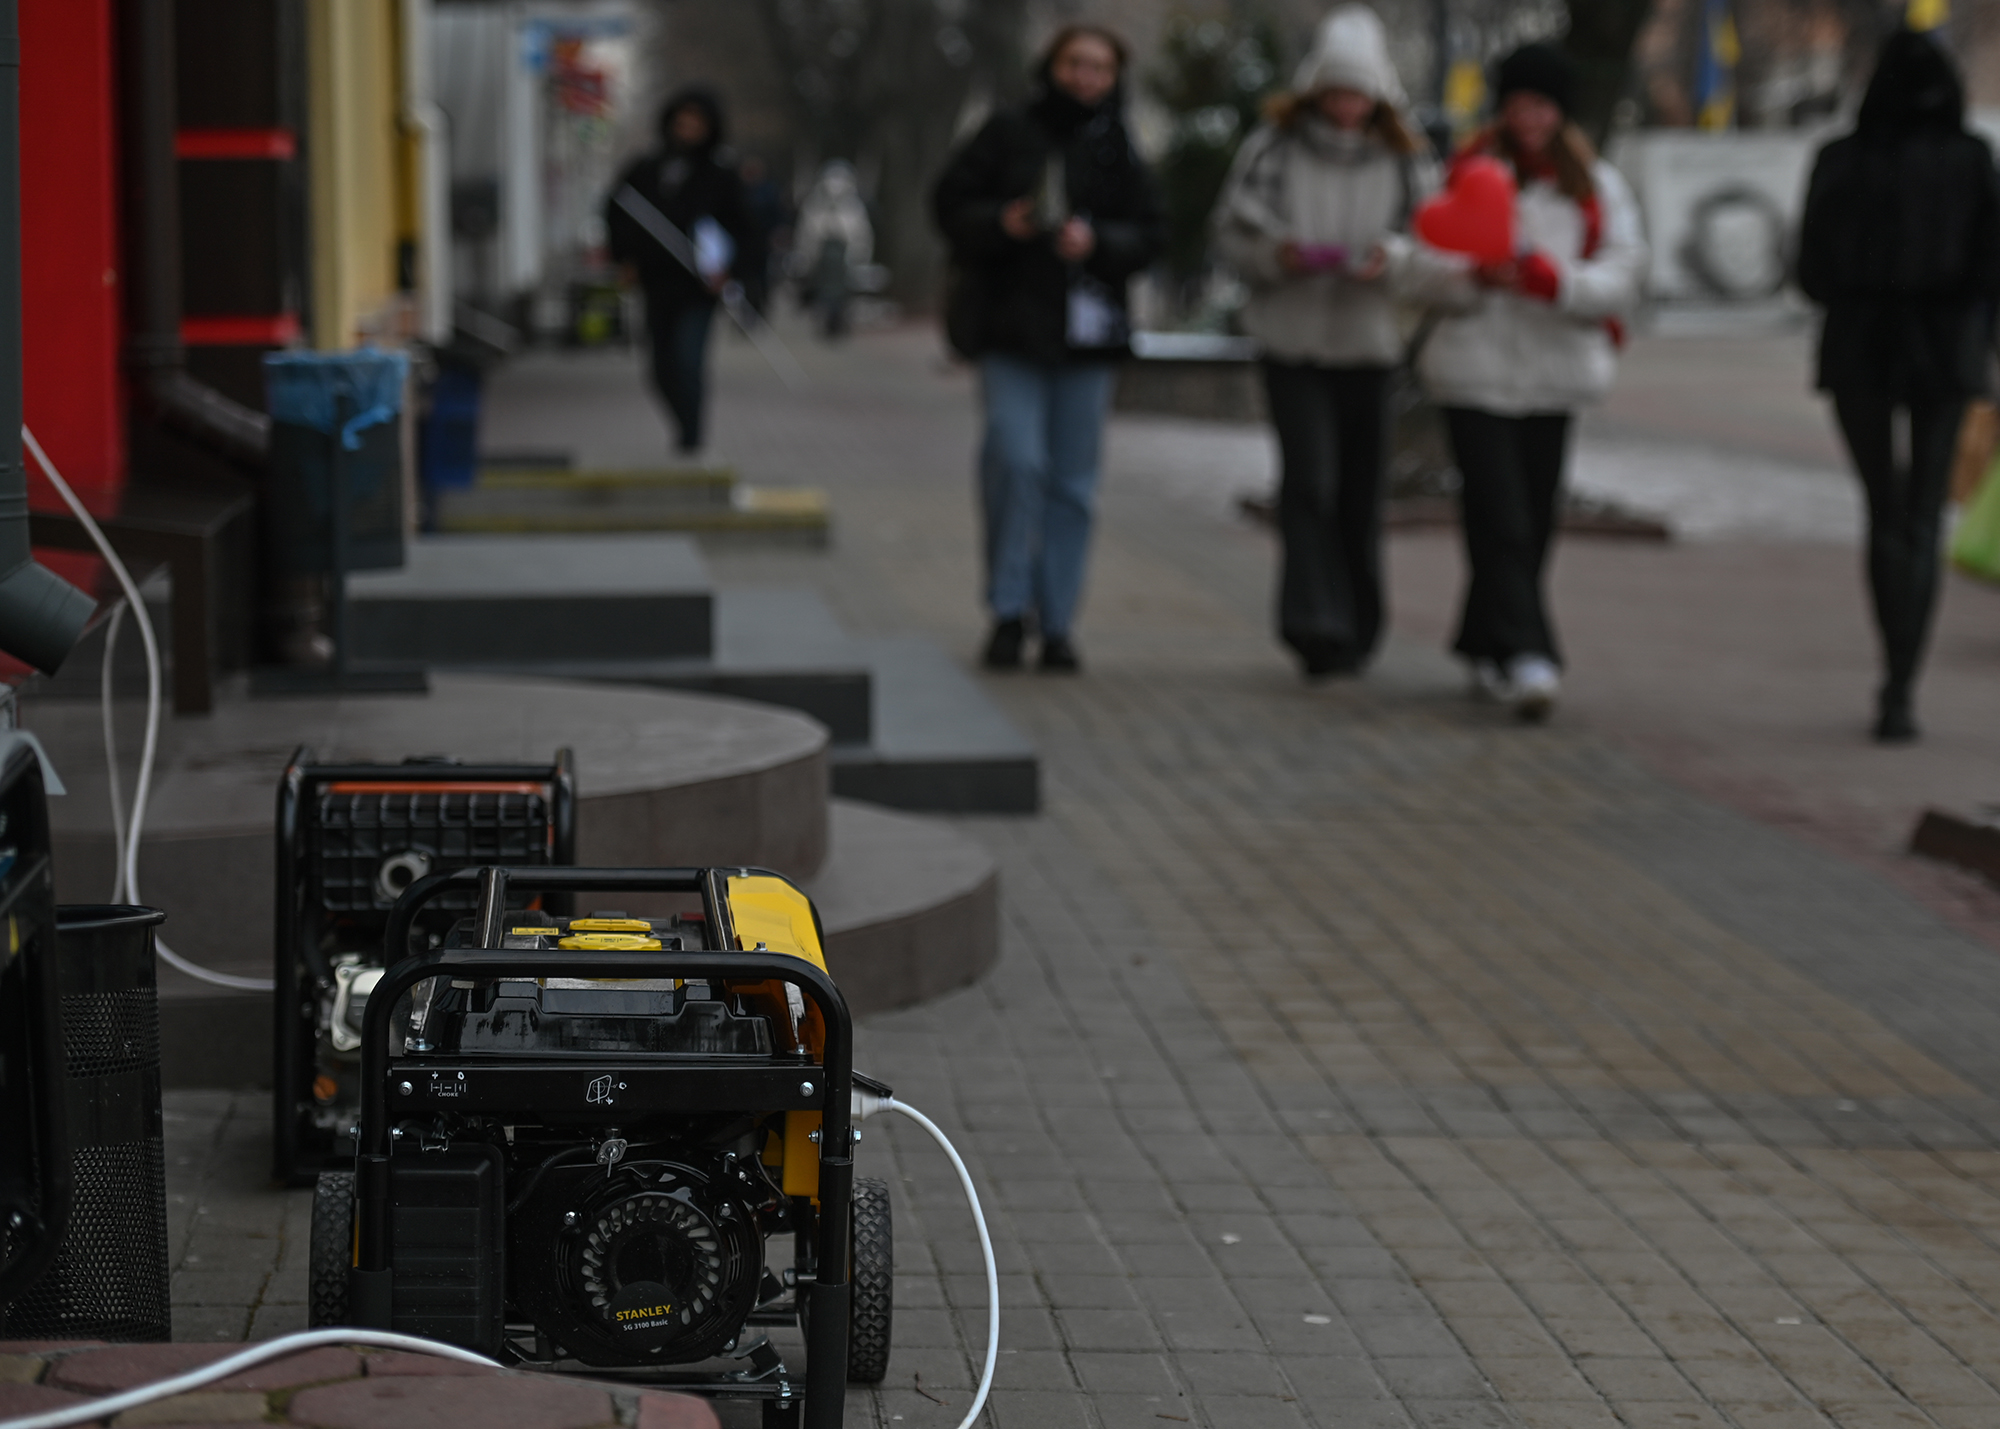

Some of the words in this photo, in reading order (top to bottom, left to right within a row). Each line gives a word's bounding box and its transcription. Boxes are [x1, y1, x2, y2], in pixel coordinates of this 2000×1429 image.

[616, 1304, 671, 1321] STANLEY
[623, 1324, 633, 1332] SG
[634, 1322, 649, 1330] 3100
[650, 1319, 668, 1328] Basic
